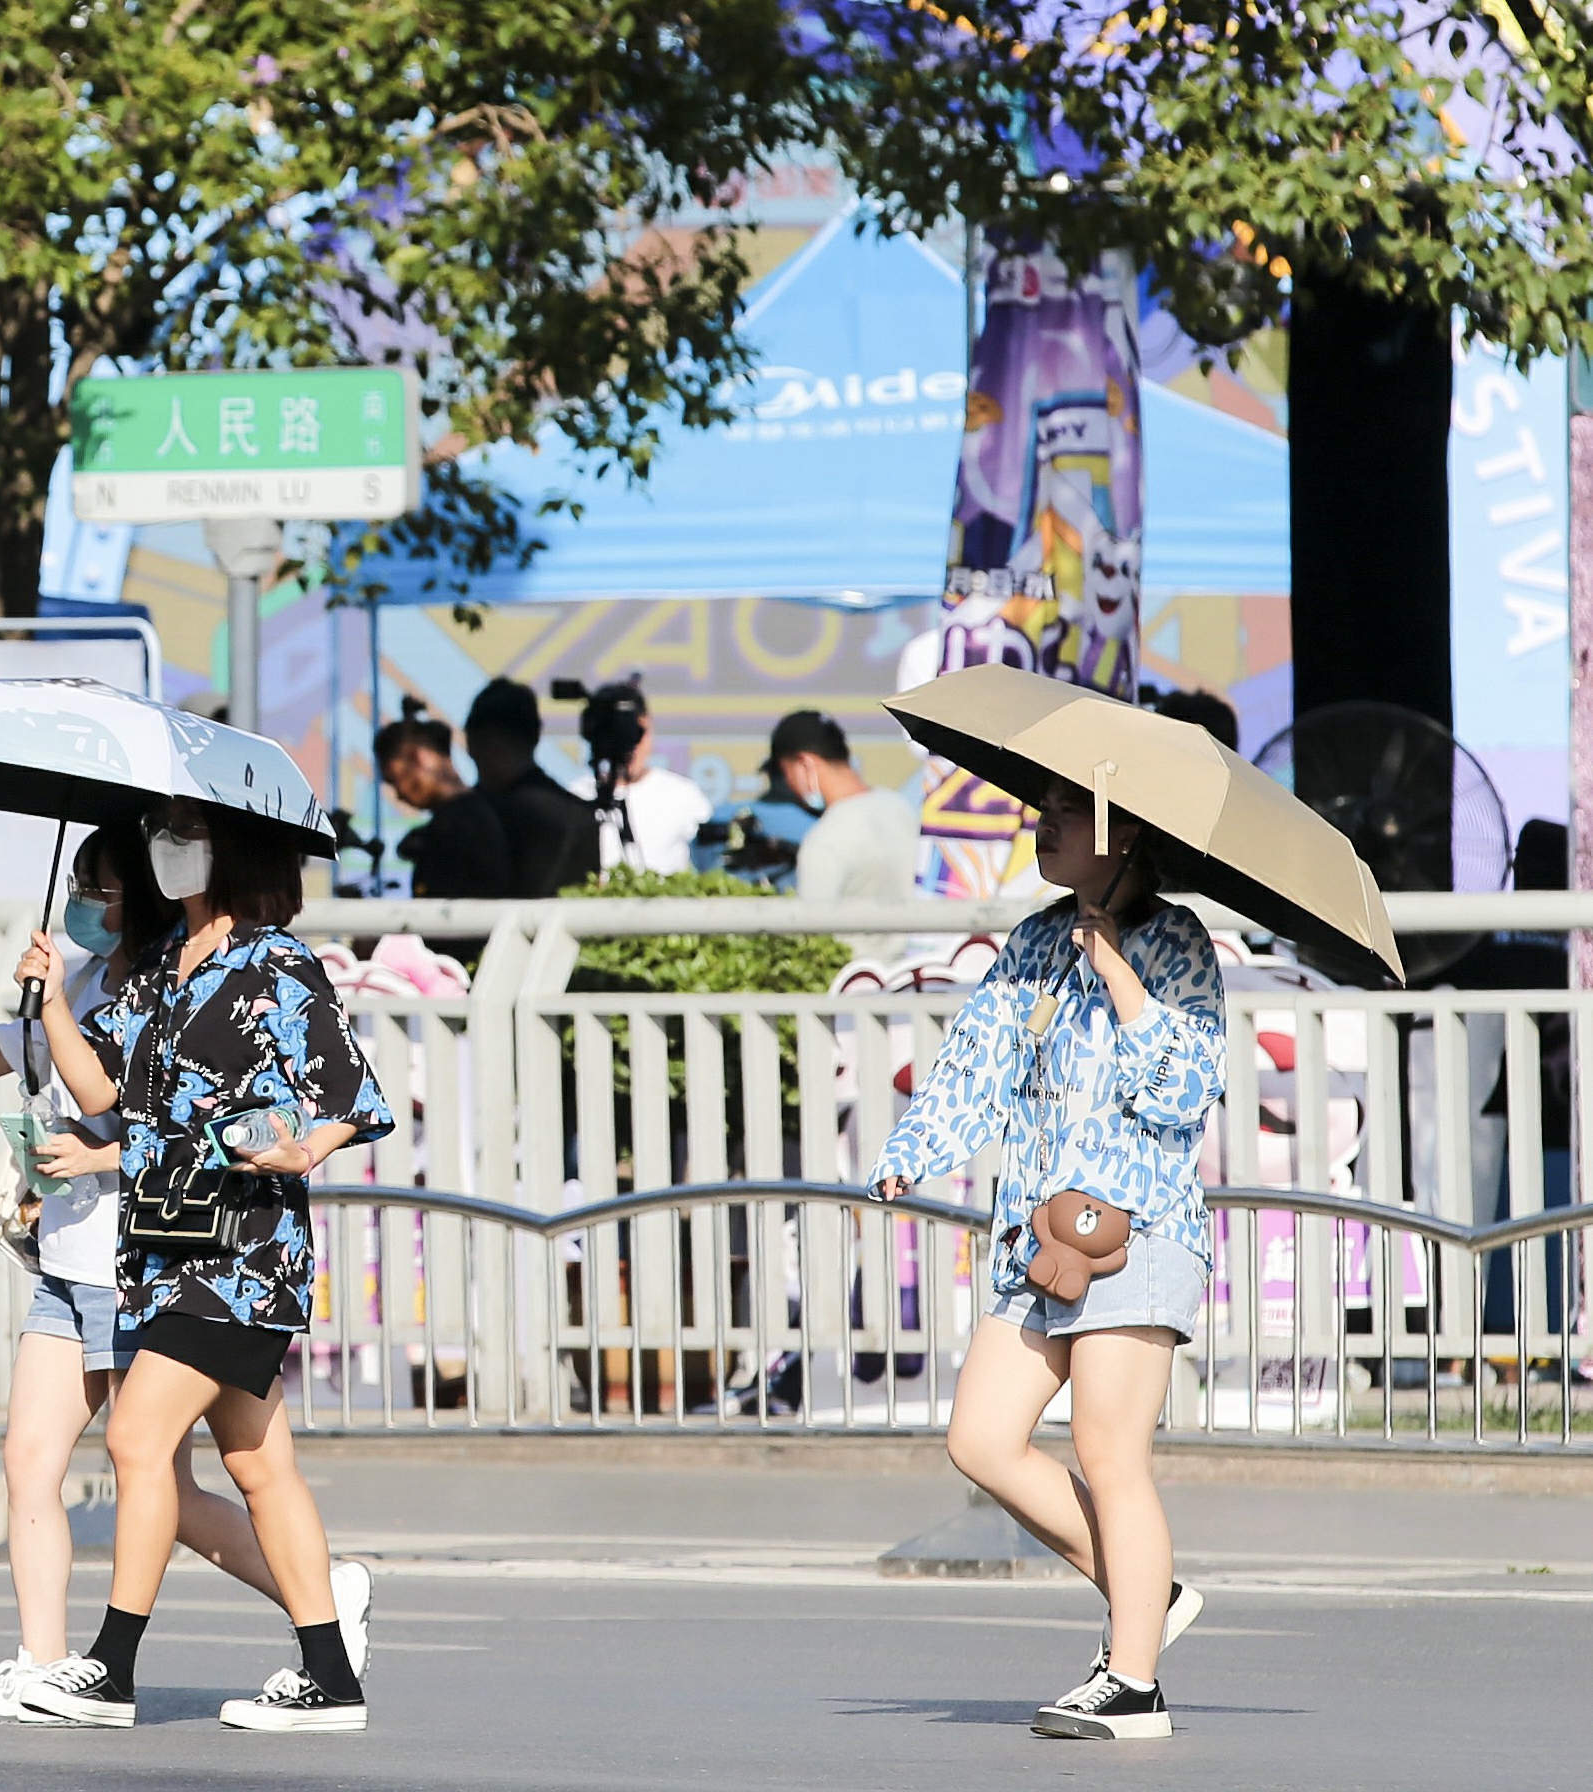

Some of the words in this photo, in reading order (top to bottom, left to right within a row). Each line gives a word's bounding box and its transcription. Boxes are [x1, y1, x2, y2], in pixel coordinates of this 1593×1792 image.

[157, 394, 321, 457] 人民路
[167, 478, 263, 505] RENMIN
[278, 476, 312, 504] LU
[363, 473, 381, 502] S
